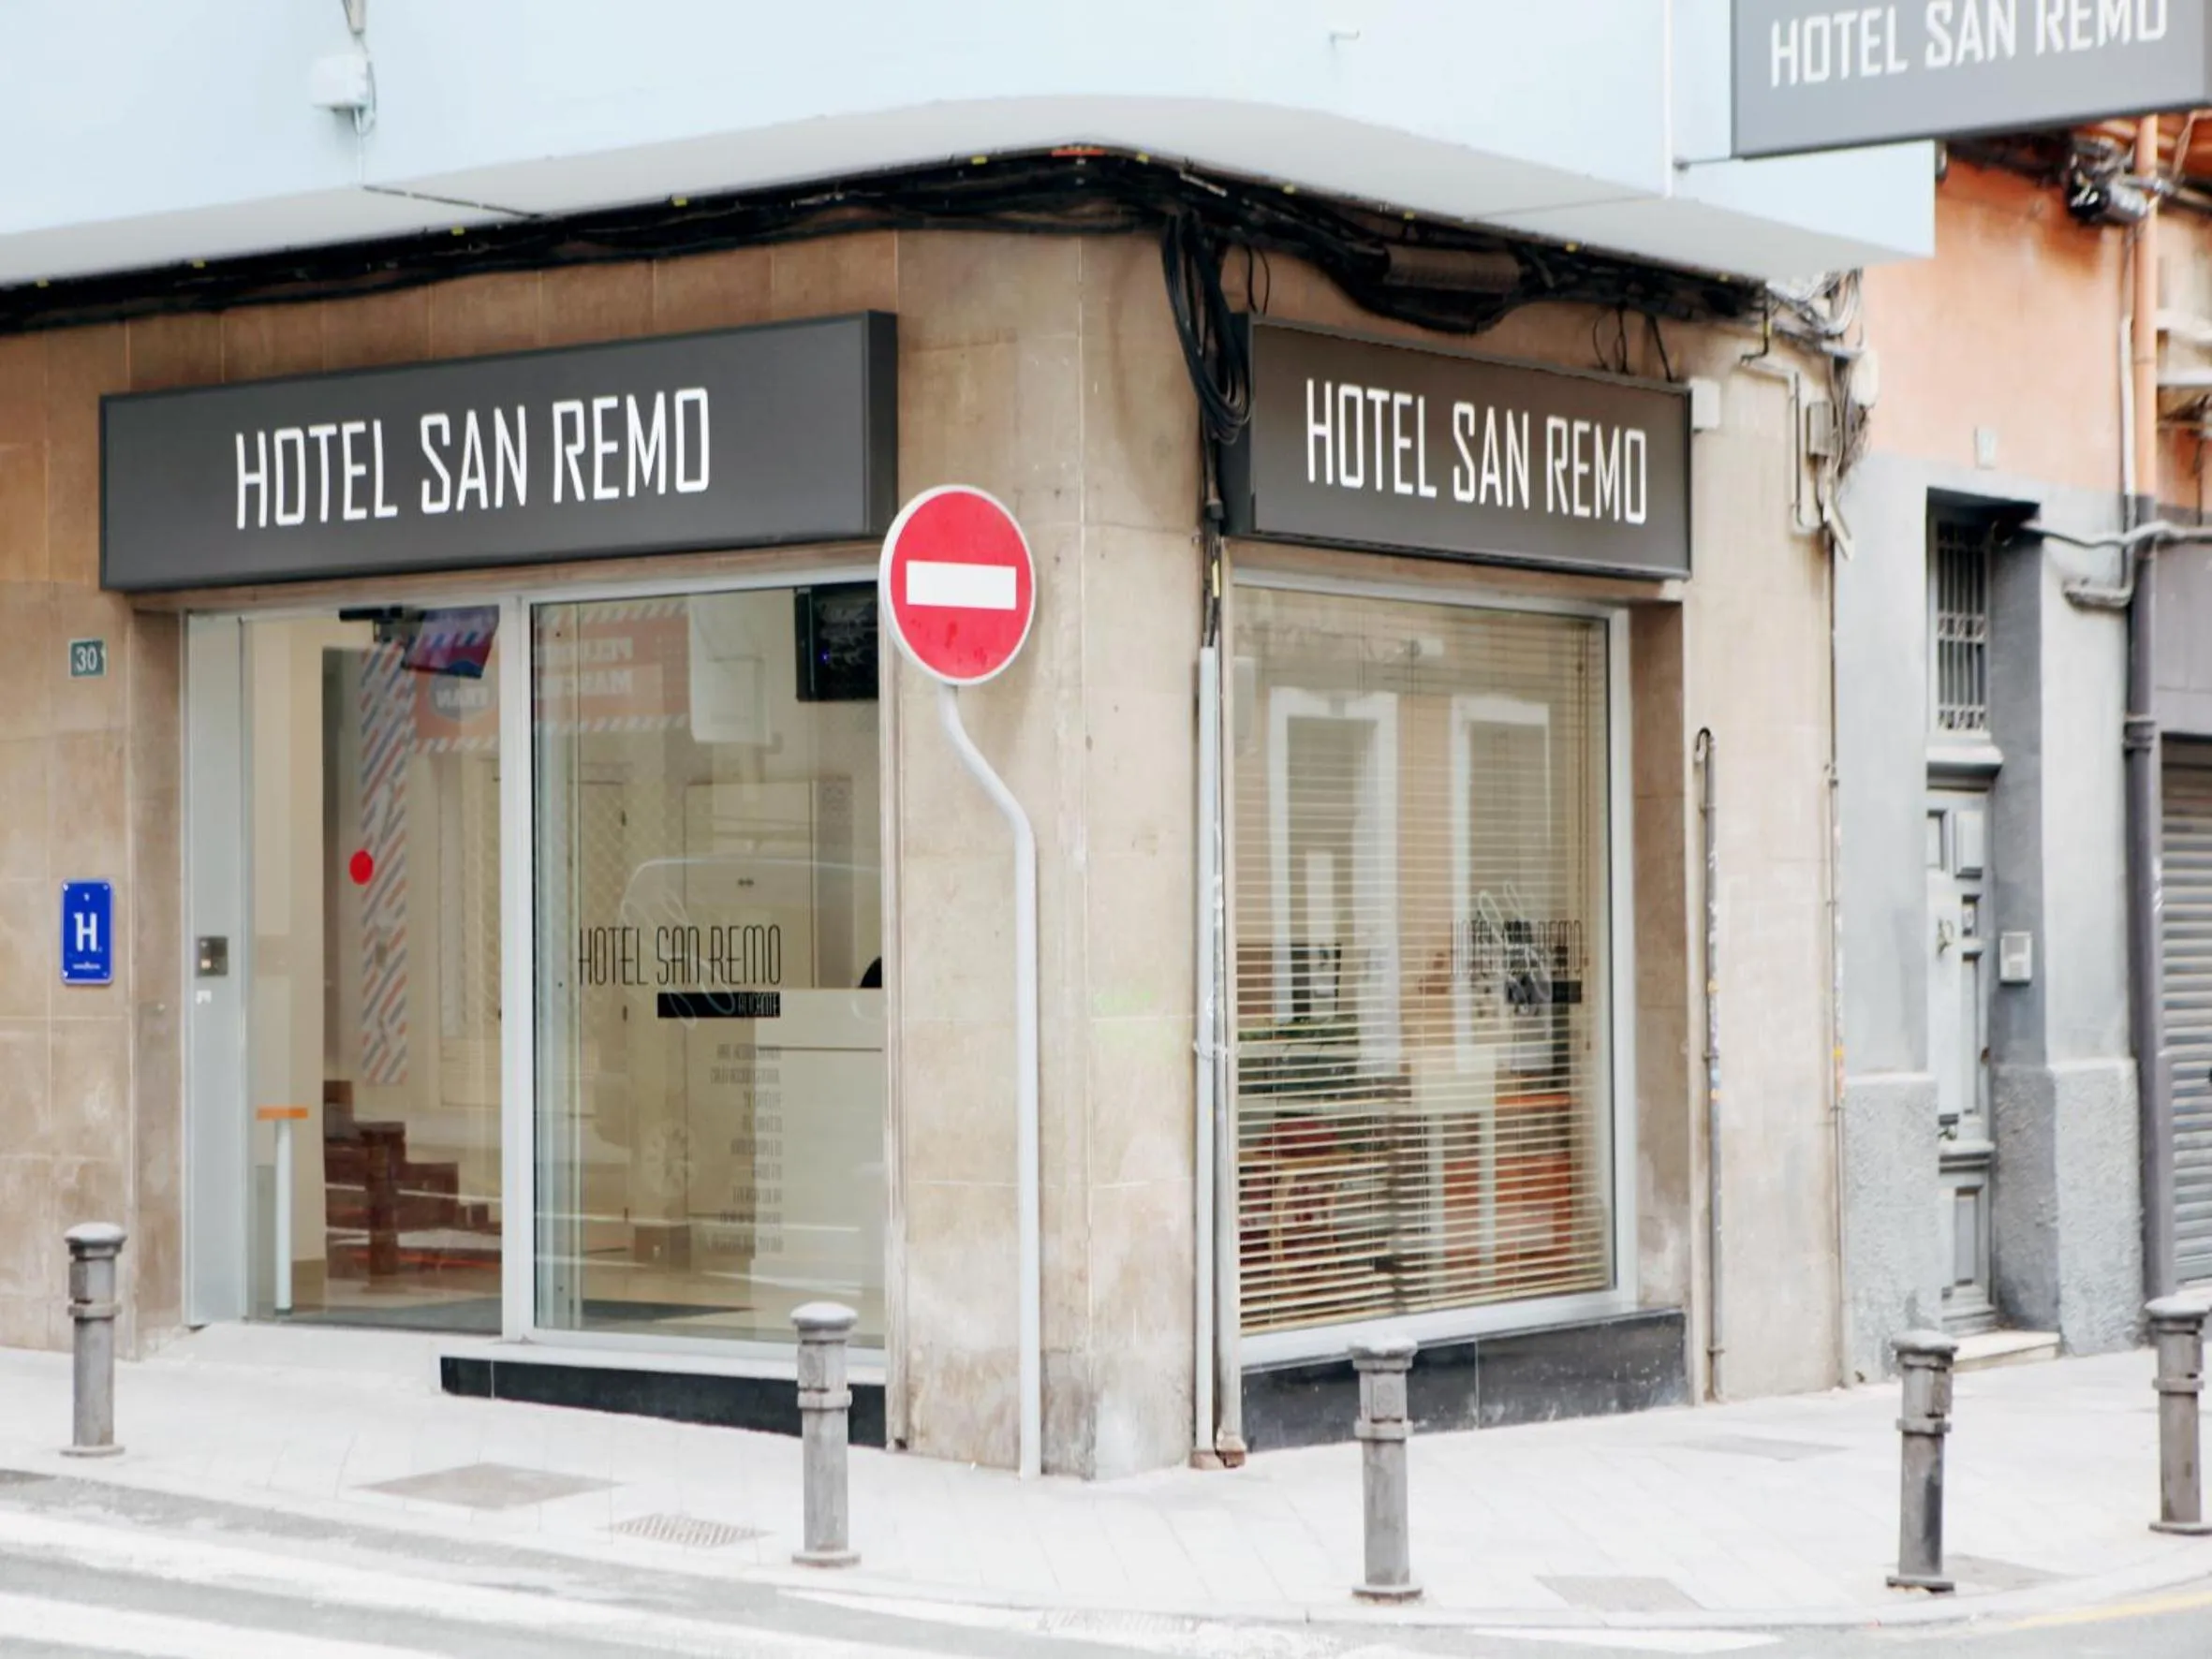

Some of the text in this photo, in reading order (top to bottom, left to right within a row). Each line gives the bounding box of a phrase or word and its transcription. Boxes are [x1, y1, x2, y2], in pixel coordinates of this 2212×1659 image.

[1770, 0, 2168, 89] HOTEL SAN REMO
[235, 387, 710, 530] HOTEL SAN REMO
[1306, 377, 1647, 525] HOTEL SAN REMO
[76, 644, 97, 672] 30
[73, 911, 97, 952] H
[578, 923, 781, 986] HOTEL SAN REMO
